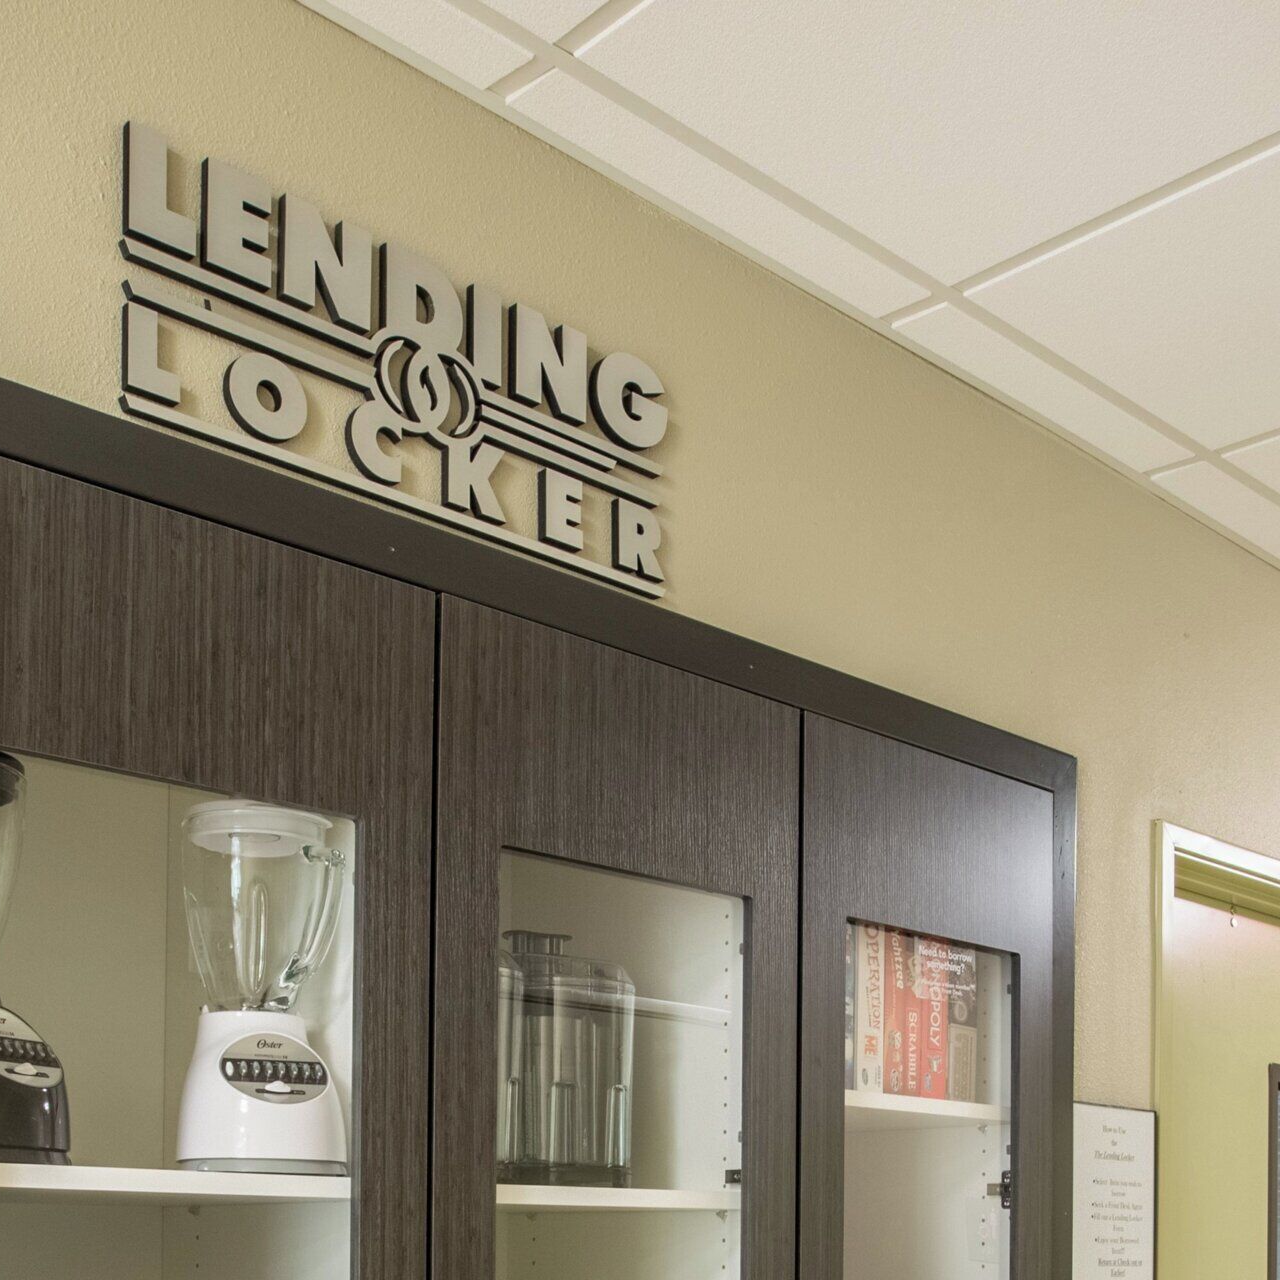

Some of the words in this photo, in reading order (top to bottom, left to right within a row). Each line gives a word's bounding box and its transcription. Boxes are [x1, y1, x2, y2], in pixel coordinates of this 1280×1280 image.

[122, 120, 669, 450] LENDING
[121, 301, 664, 583] LOCKER
[865, 925, 881, 1030] OPERATION
[891, 930, 905, 990] Yahtzee
[948, 949, 974, 962] borrow
[256, 1039, 283, 1049] Oster
[908, 1011, 918, 1090] SCRABBLE
